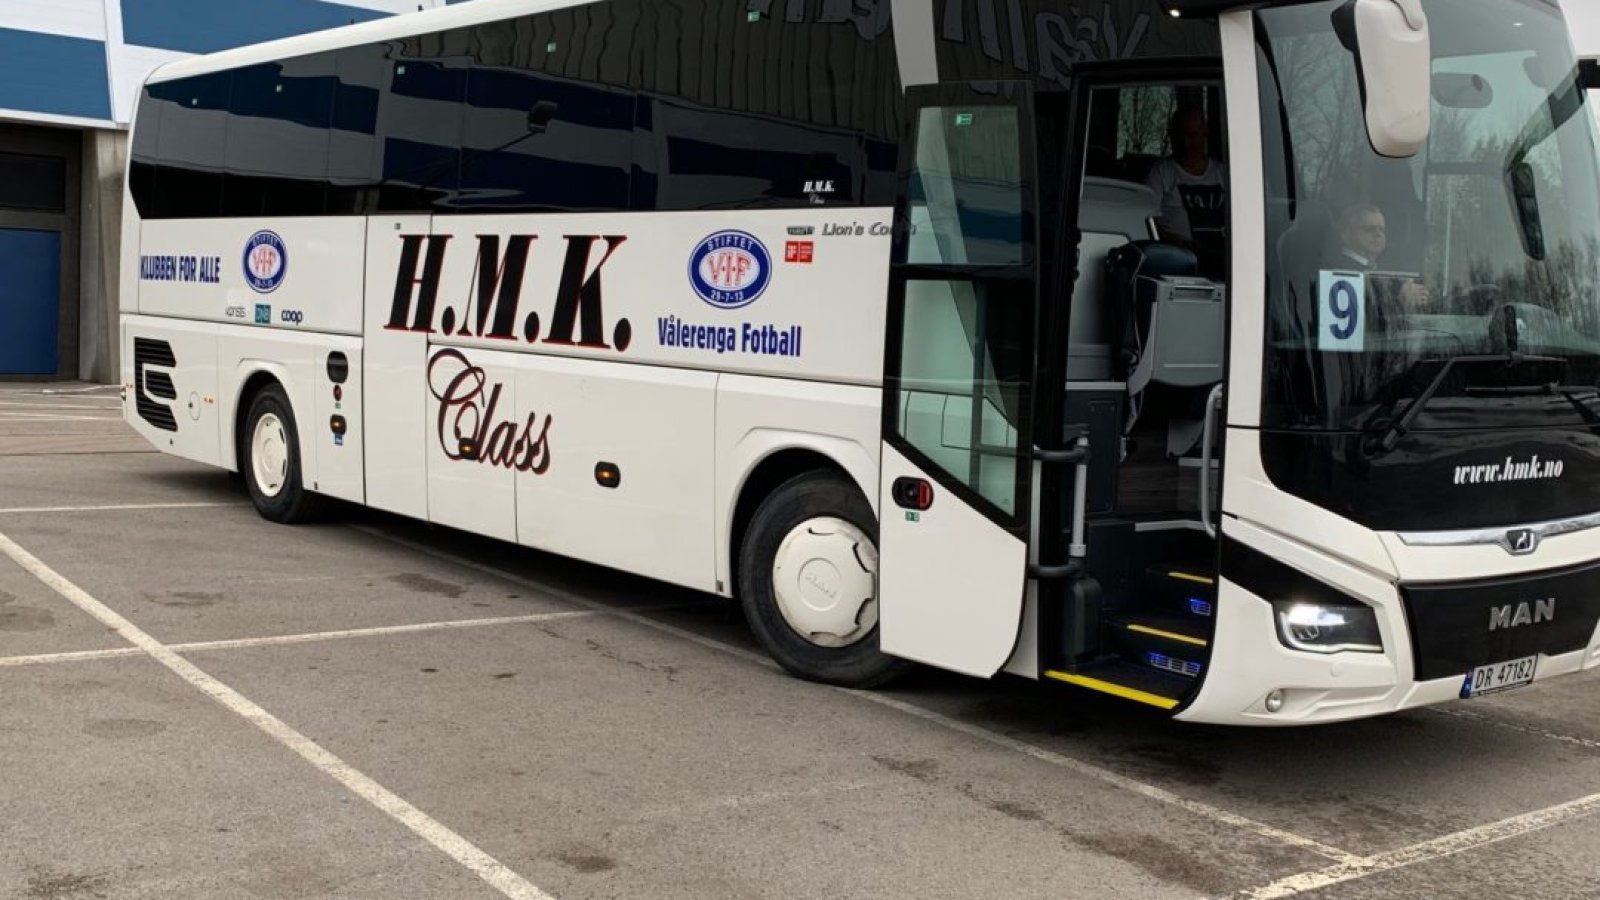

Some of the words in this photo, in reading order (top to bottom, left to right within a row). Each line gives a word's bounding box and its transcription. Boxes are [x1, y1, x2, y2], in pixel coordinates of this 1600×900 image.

[707, 236, 753, 251] STIFTET
[822, 222, 864, 236] Lion's
[140, 256, 177, 281] KLUBBEN
[179, 256, 197, 282] FOR
[200, 256, 220, 283] ALLE
[384, 234, 632, 352] H.M.K.
[281, 310, 303, 325] coop
[1328, 279, 1358, 340] 9
[658, 314, 736, 354] Vålerenga
[742, 322, 801, 357] Fotball
[428, 348, 552, 475] Class
[1454, 454, 1564, 484] www.hmk.no
[1488, 597, 1555, 631] MAN
[1475, 667, 1493, 689] DR
[1498, 658, 1533, 684] 47182
